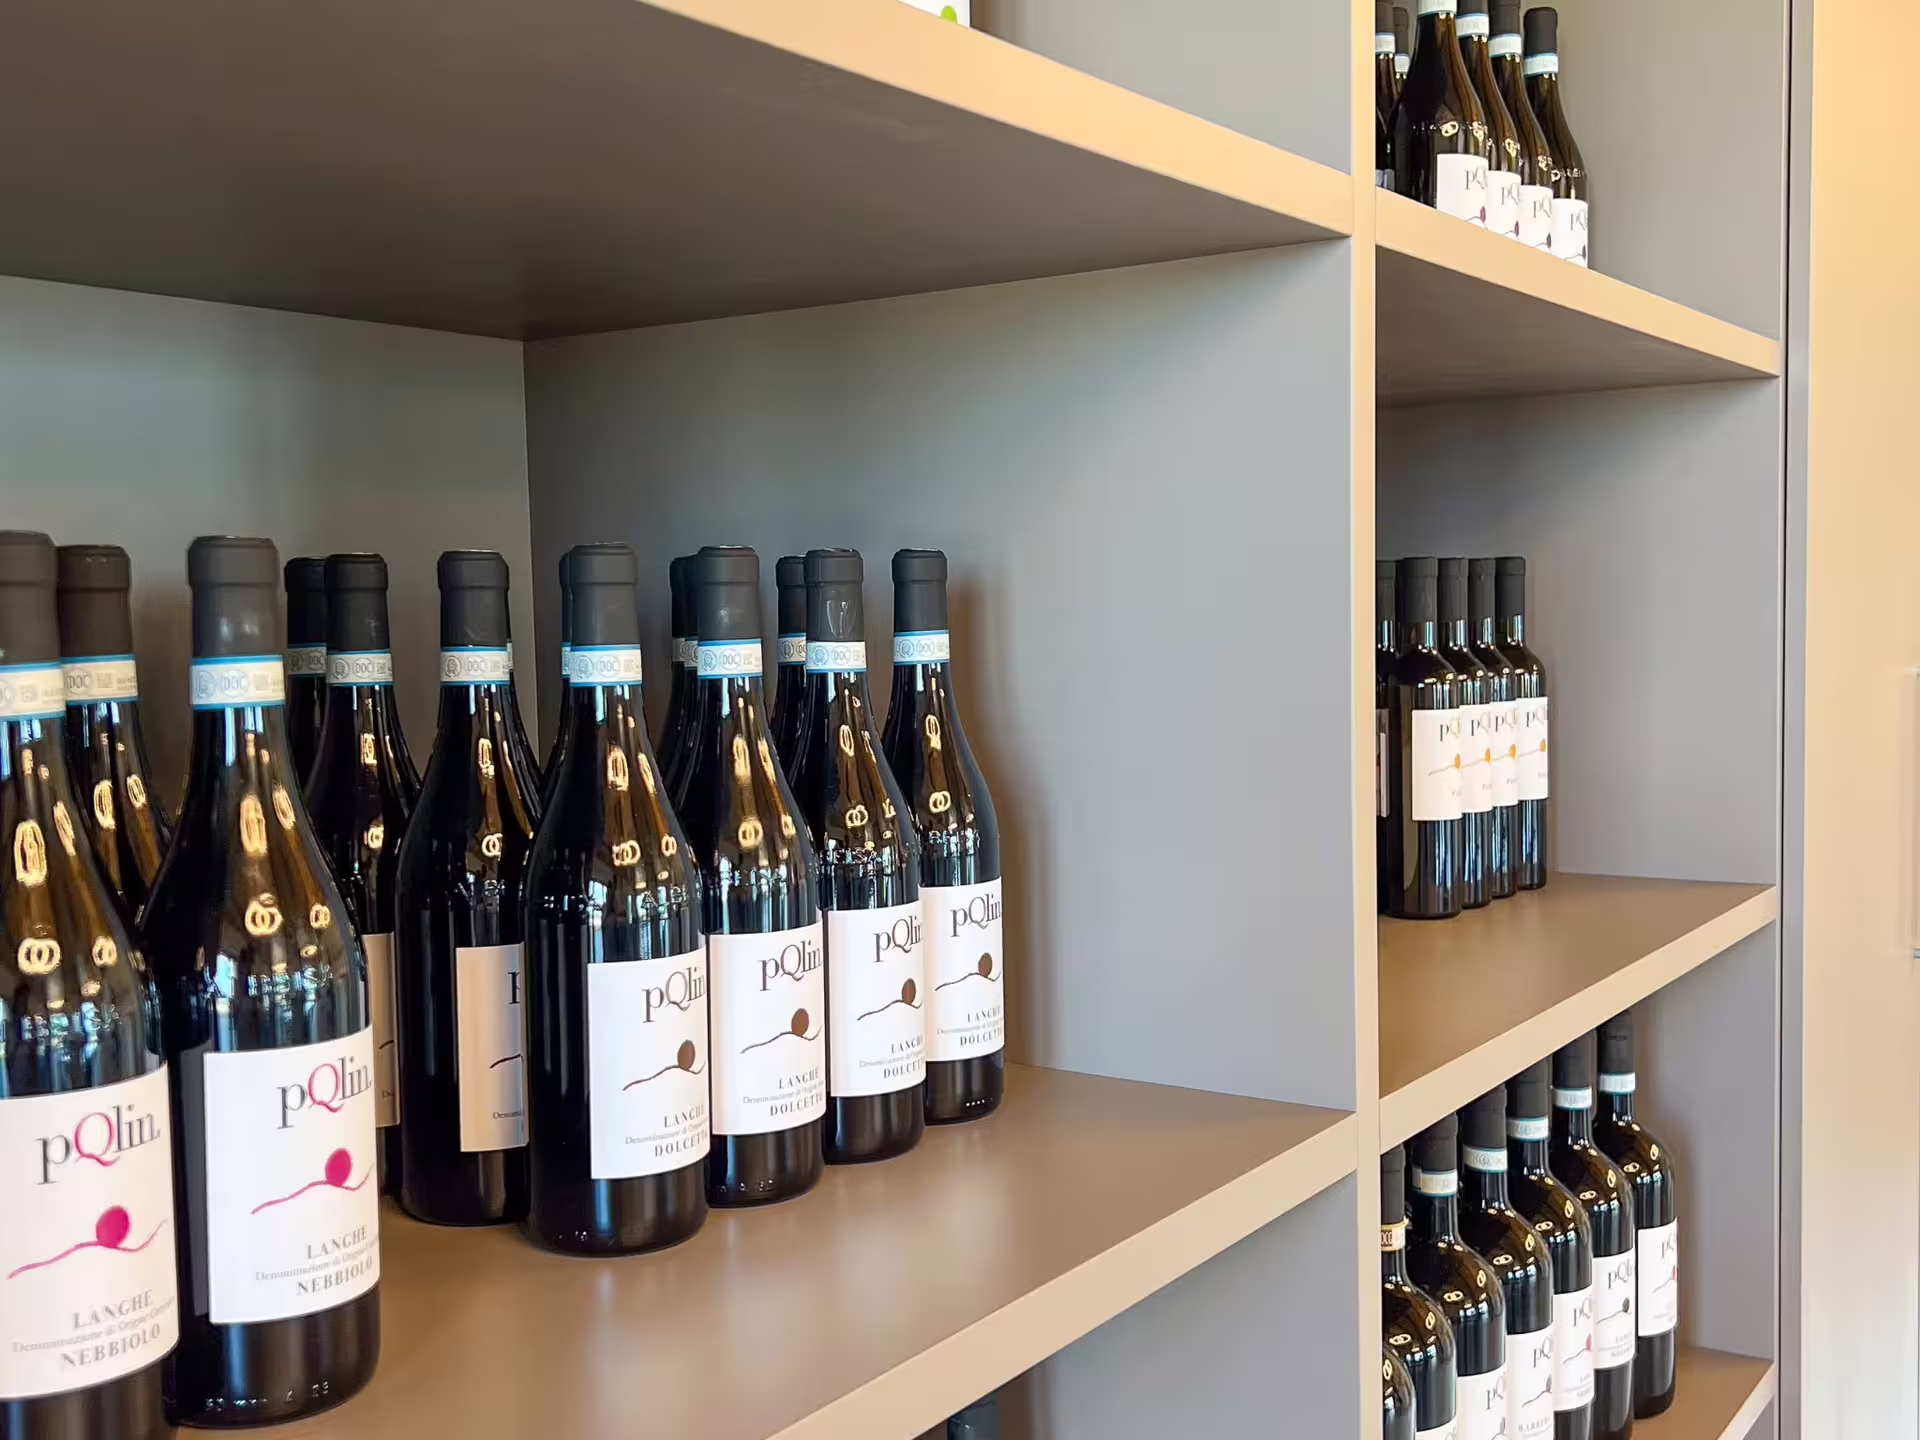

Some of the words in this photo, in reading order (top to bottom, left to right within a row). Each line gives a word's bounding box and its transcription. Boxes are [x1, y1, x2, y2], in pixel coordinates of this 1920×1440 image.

[758, 940, 822, 991] pQlin
[641, 966, 706, 1023] pQlin
[890, 1034, 923, 1054] LANGH
[275, 1056, 372, 1129] pQlin
[35, 1104, 161, 1185] pQlin
[305, 1225, 367, 1260] LANGHE
[296, 1255, 373, 1297] NEBBIOLO
[73, 1289, 153, 1329] LANGHE
[60, 1322, 161, 1369] NEBBIOLO
